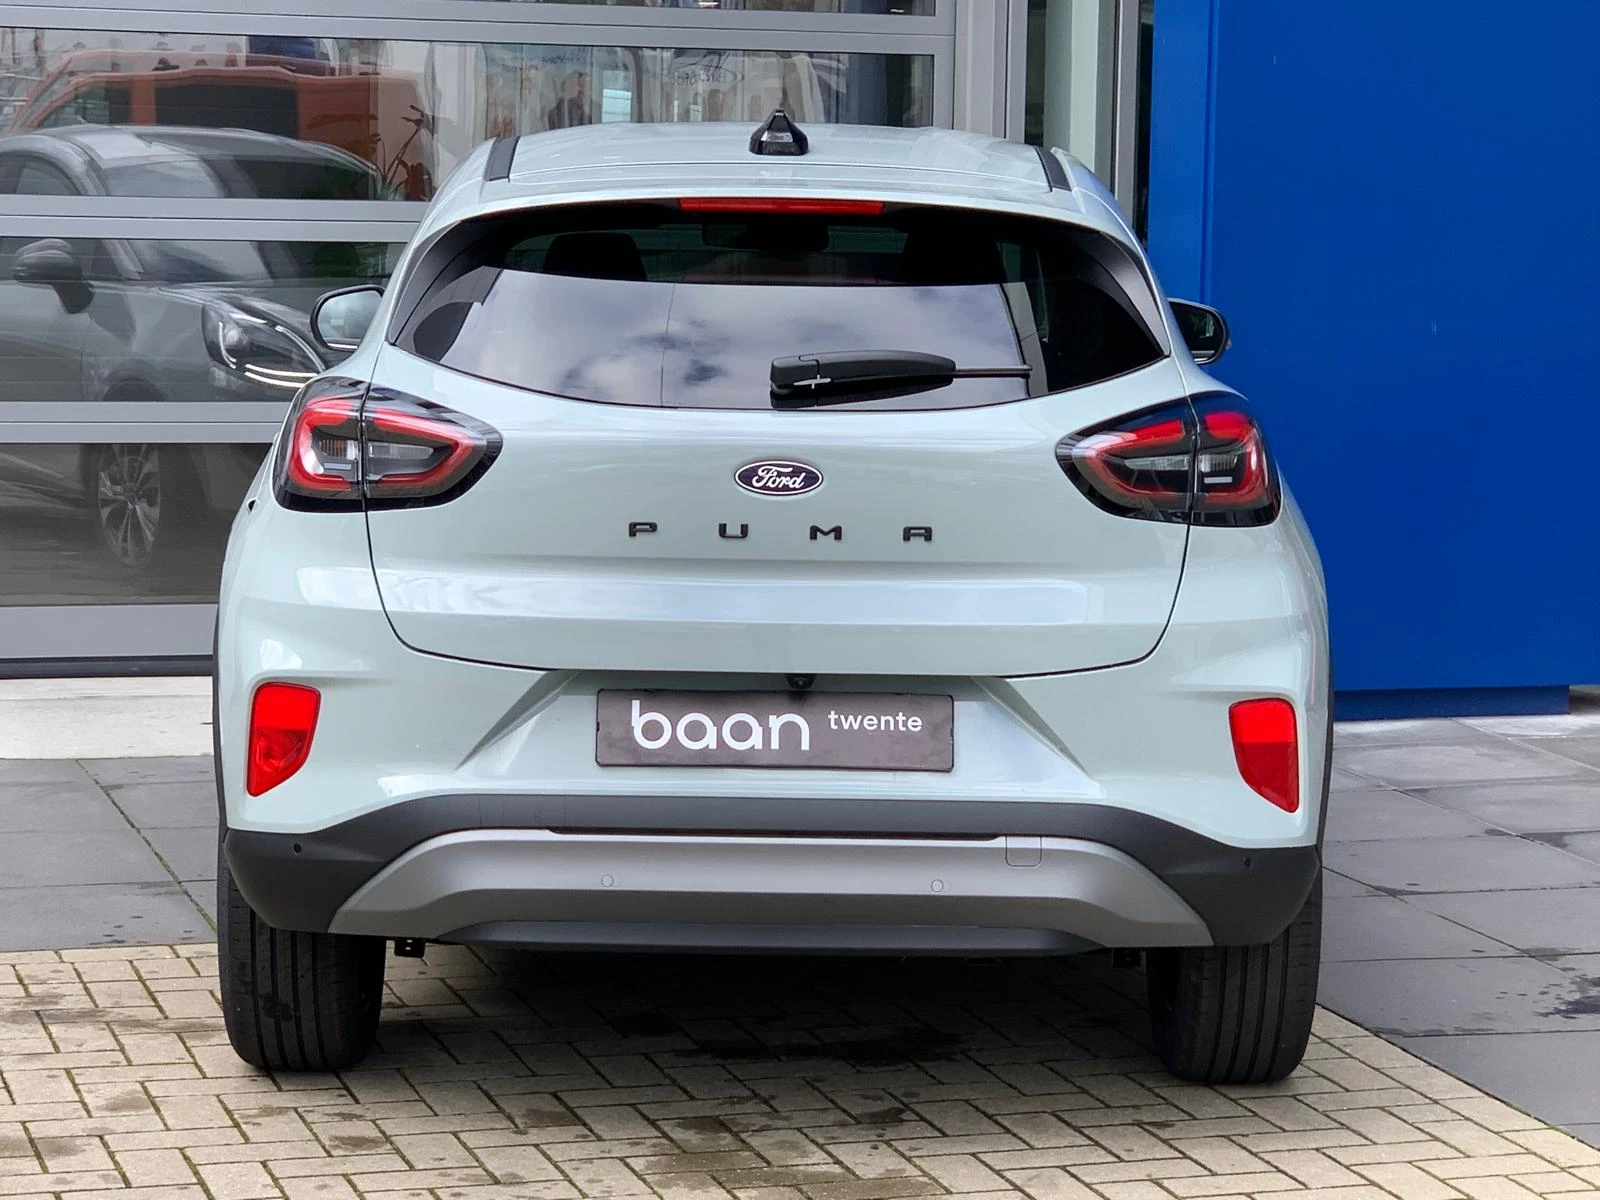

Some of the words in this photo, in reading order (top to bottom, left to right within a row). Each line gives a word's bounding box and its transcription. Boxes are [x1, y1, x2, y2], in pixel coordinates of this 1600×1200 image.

[751, 465, 805, 488] Ford
[628, 522, 933, 542] PUMA
[631, 700, 810, 751] baan
[828, 710, 923, 732] twente
